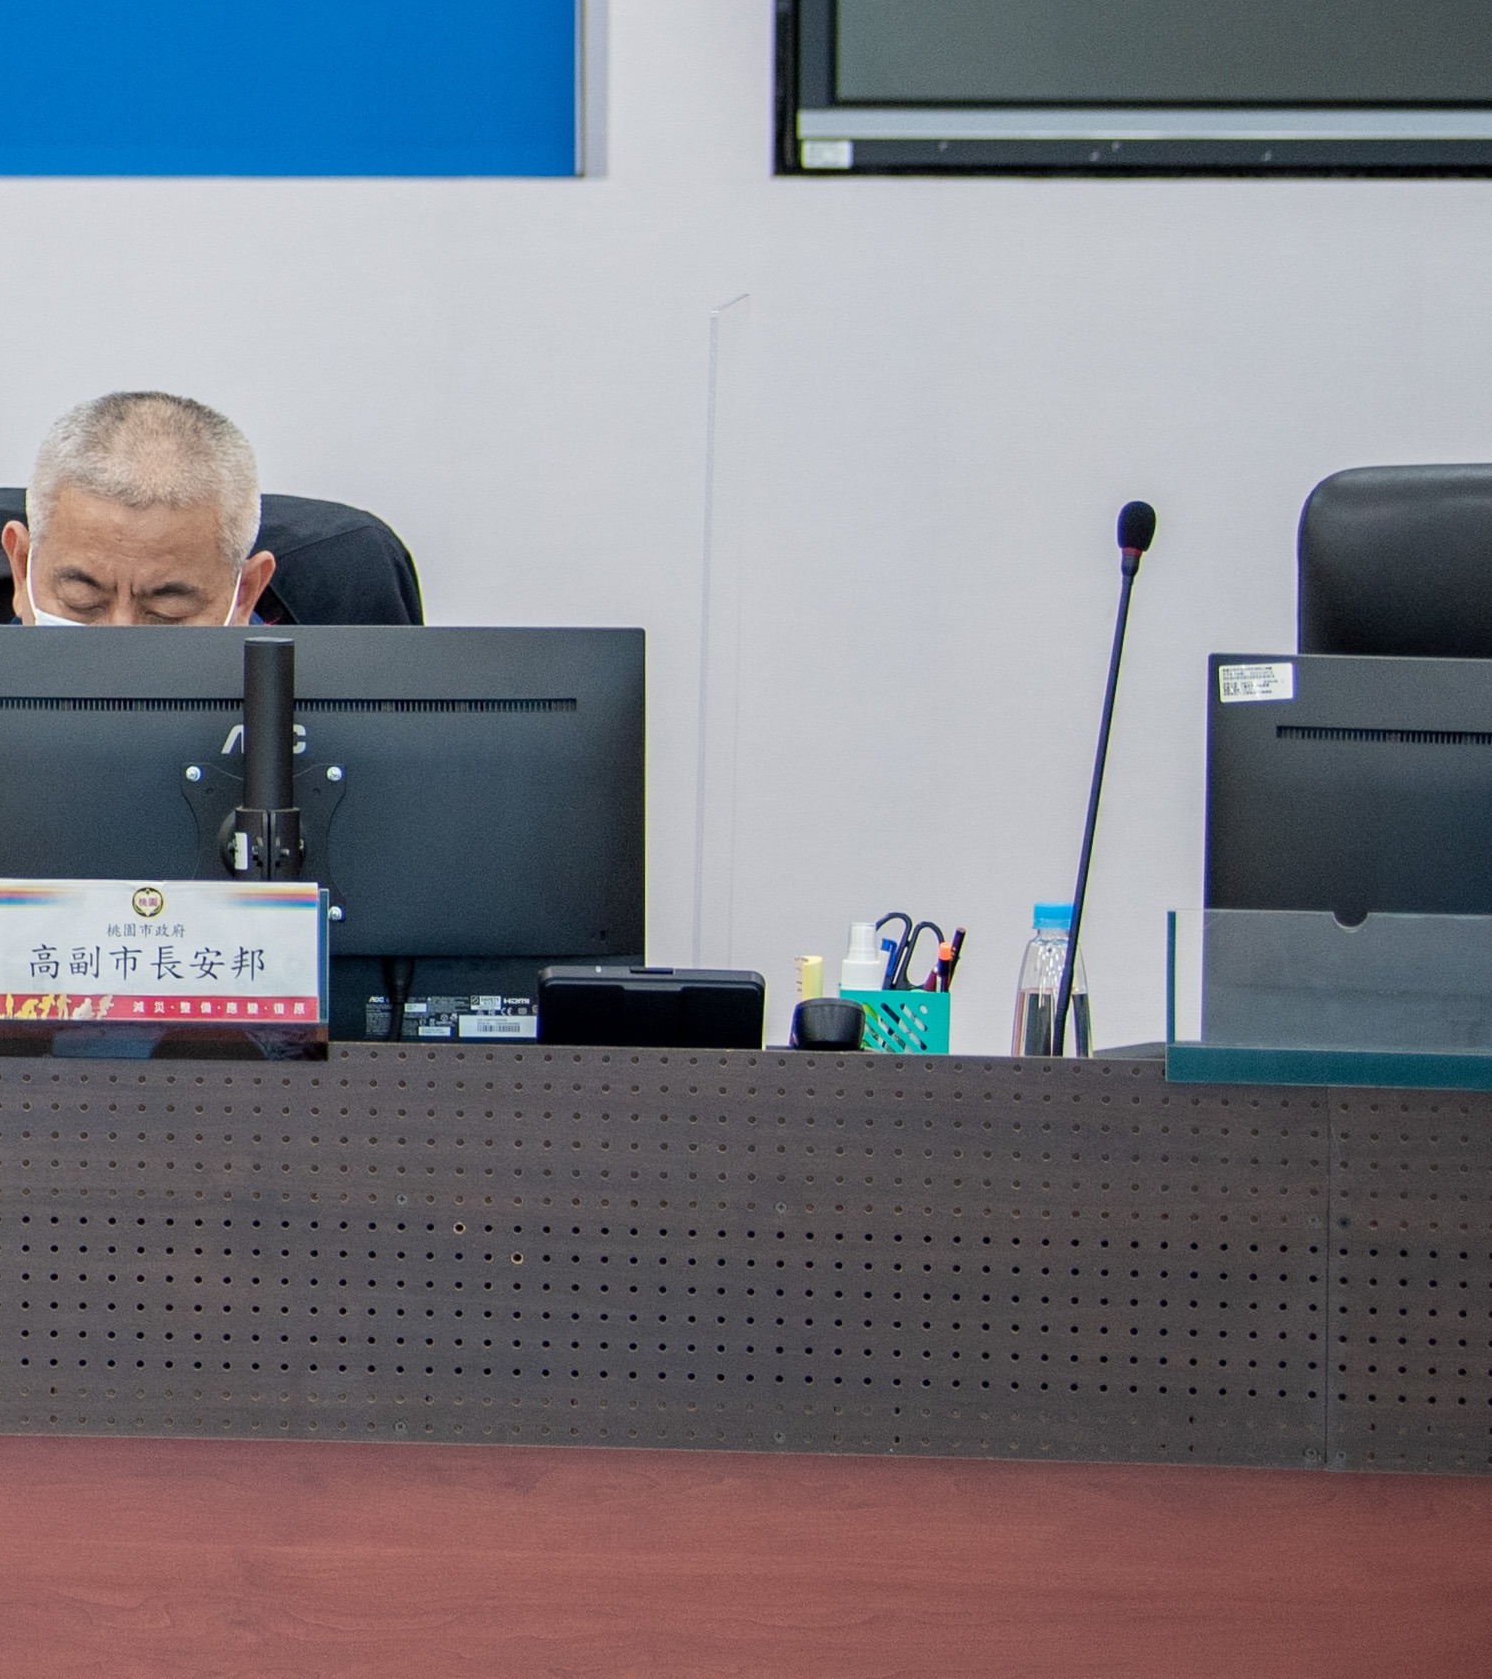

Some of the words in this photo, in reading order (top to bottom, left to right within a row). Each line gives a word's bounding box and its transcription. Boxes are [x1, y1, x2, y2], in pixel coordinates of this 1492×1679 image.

[138, 897, 158, 908] 桃園
[106, 923, 186, 938] 桃園市政府
[29, 943, 266, 982] 高副市長安邦
